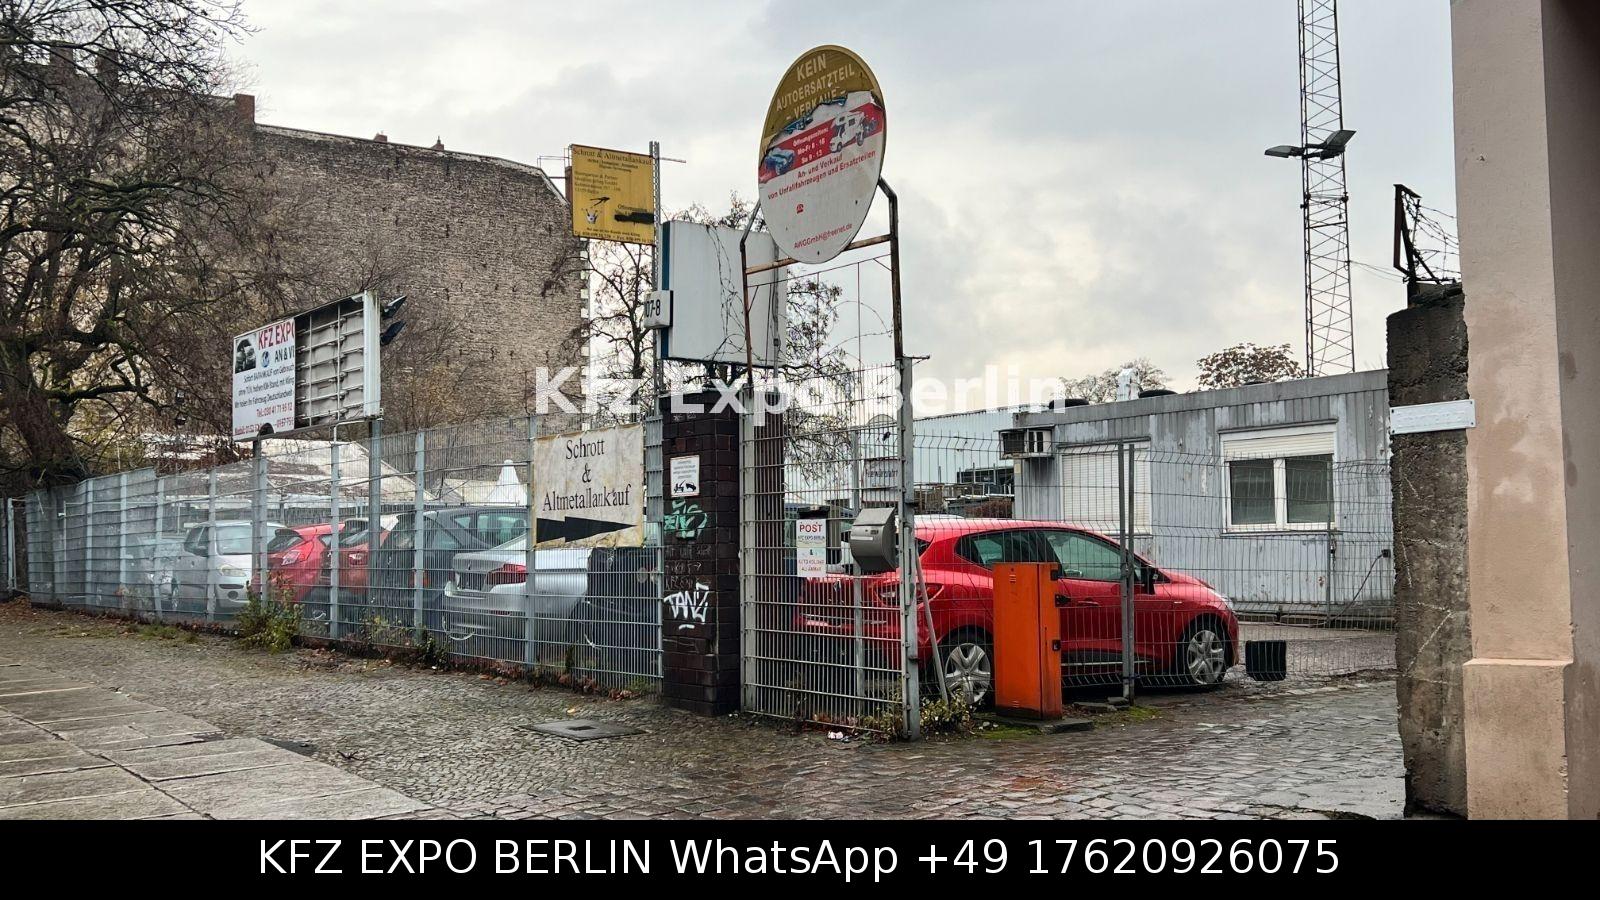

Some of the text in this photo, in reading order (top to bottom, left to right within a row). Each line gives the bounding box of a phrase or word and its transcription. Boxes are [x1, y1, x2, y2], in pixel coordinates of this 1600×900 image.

[796, 53, 827, 81] KEIN
[776, 64, 855, 112] AUTOERSATZTEIL
[768, 192, 778, 200] von
[780, 171, 826, 196] Unfallfahrzeugen
[828, 167, 839, 176] und
[839, 149, 876, 171] Ersatzteilen
[808, 165, 819, 174] und
[820, 153, 843, 169] Verkauf
[259, 326, 274, 350] KFZ
[275, 349, 283, 363] AN
[283, 347, 288, 360] &
[565, 437, 605, 460] Schrott
[581, 462, 592, 484] &
[543, 484, 632, 512] Altmetallankauf
[799, 524, 823, 533] POST
